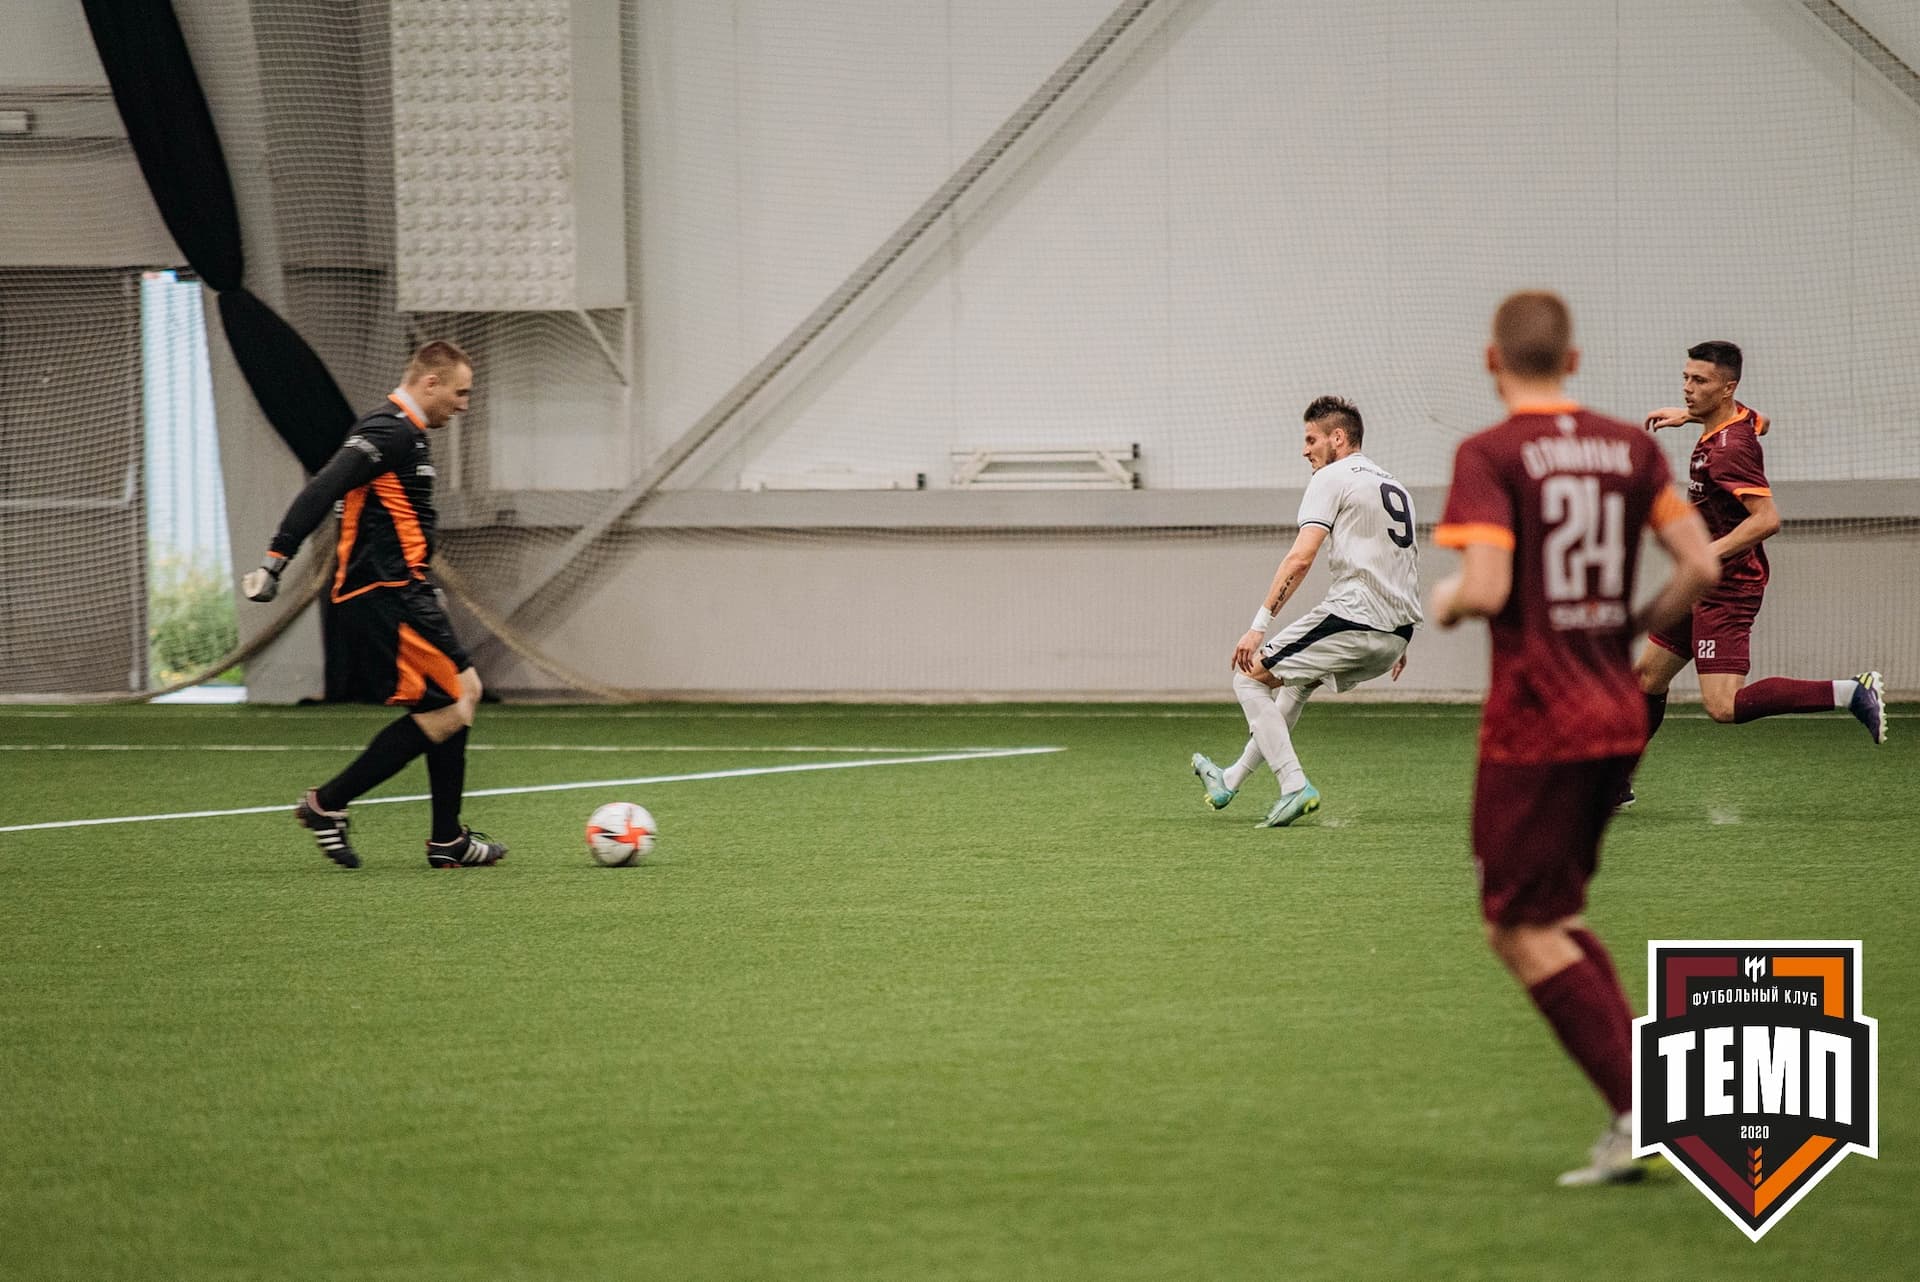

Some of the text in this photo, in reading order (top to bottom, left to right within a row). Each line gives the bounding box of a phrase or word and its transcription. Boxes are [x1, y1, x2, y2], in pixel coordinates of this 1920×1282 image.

[1380, 482, 1413, 548] 9
[1542, 475, 1626, 601] 24
[1697, 639, 1716, 659] 22
